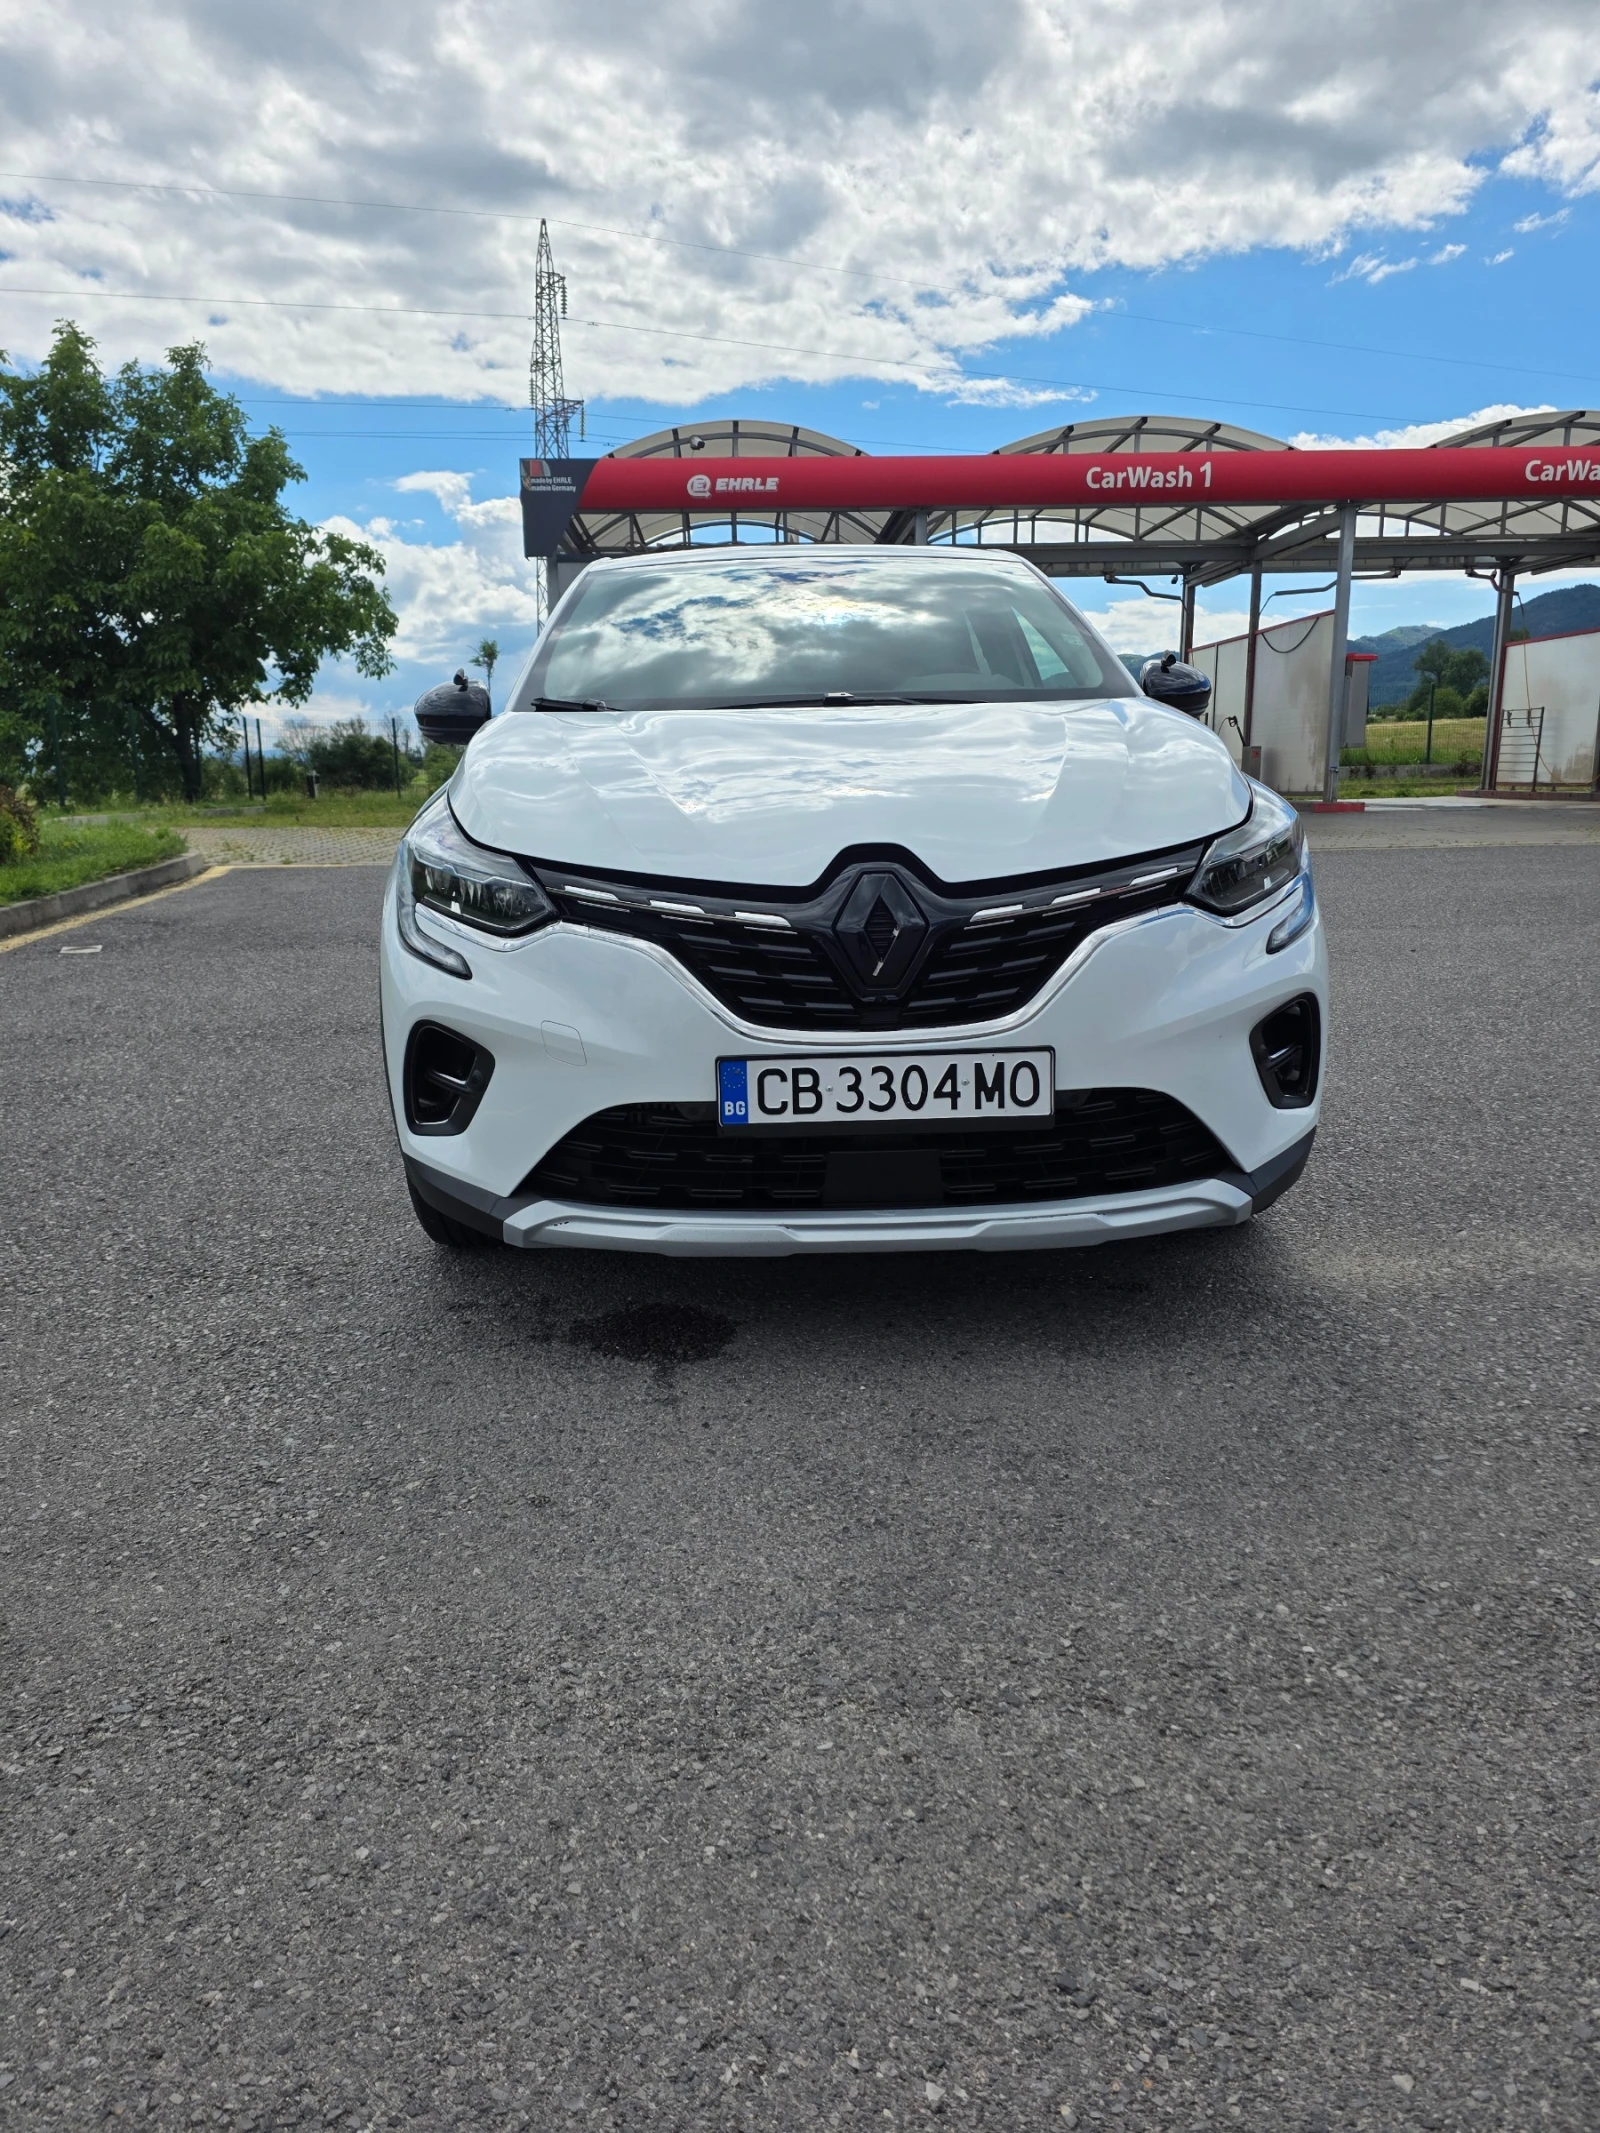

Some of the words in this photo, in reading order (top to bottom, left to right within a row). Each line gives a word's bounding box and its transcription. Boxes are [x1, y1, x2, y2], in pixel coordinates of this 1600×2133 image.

[1086, 465, 1193, 489] CarWash
[1200, 461, 1212, 488] 1
[1525, 460, 1600, 481] CarWa
[715, 477, 780, 492] EHRLE
[756, 1067, 824, 1116] CB
[836, 1063, 962, 1113] 3304
[973, 1060, 1041, 1110] MO
[724, 1100, 747, 1117] BG
